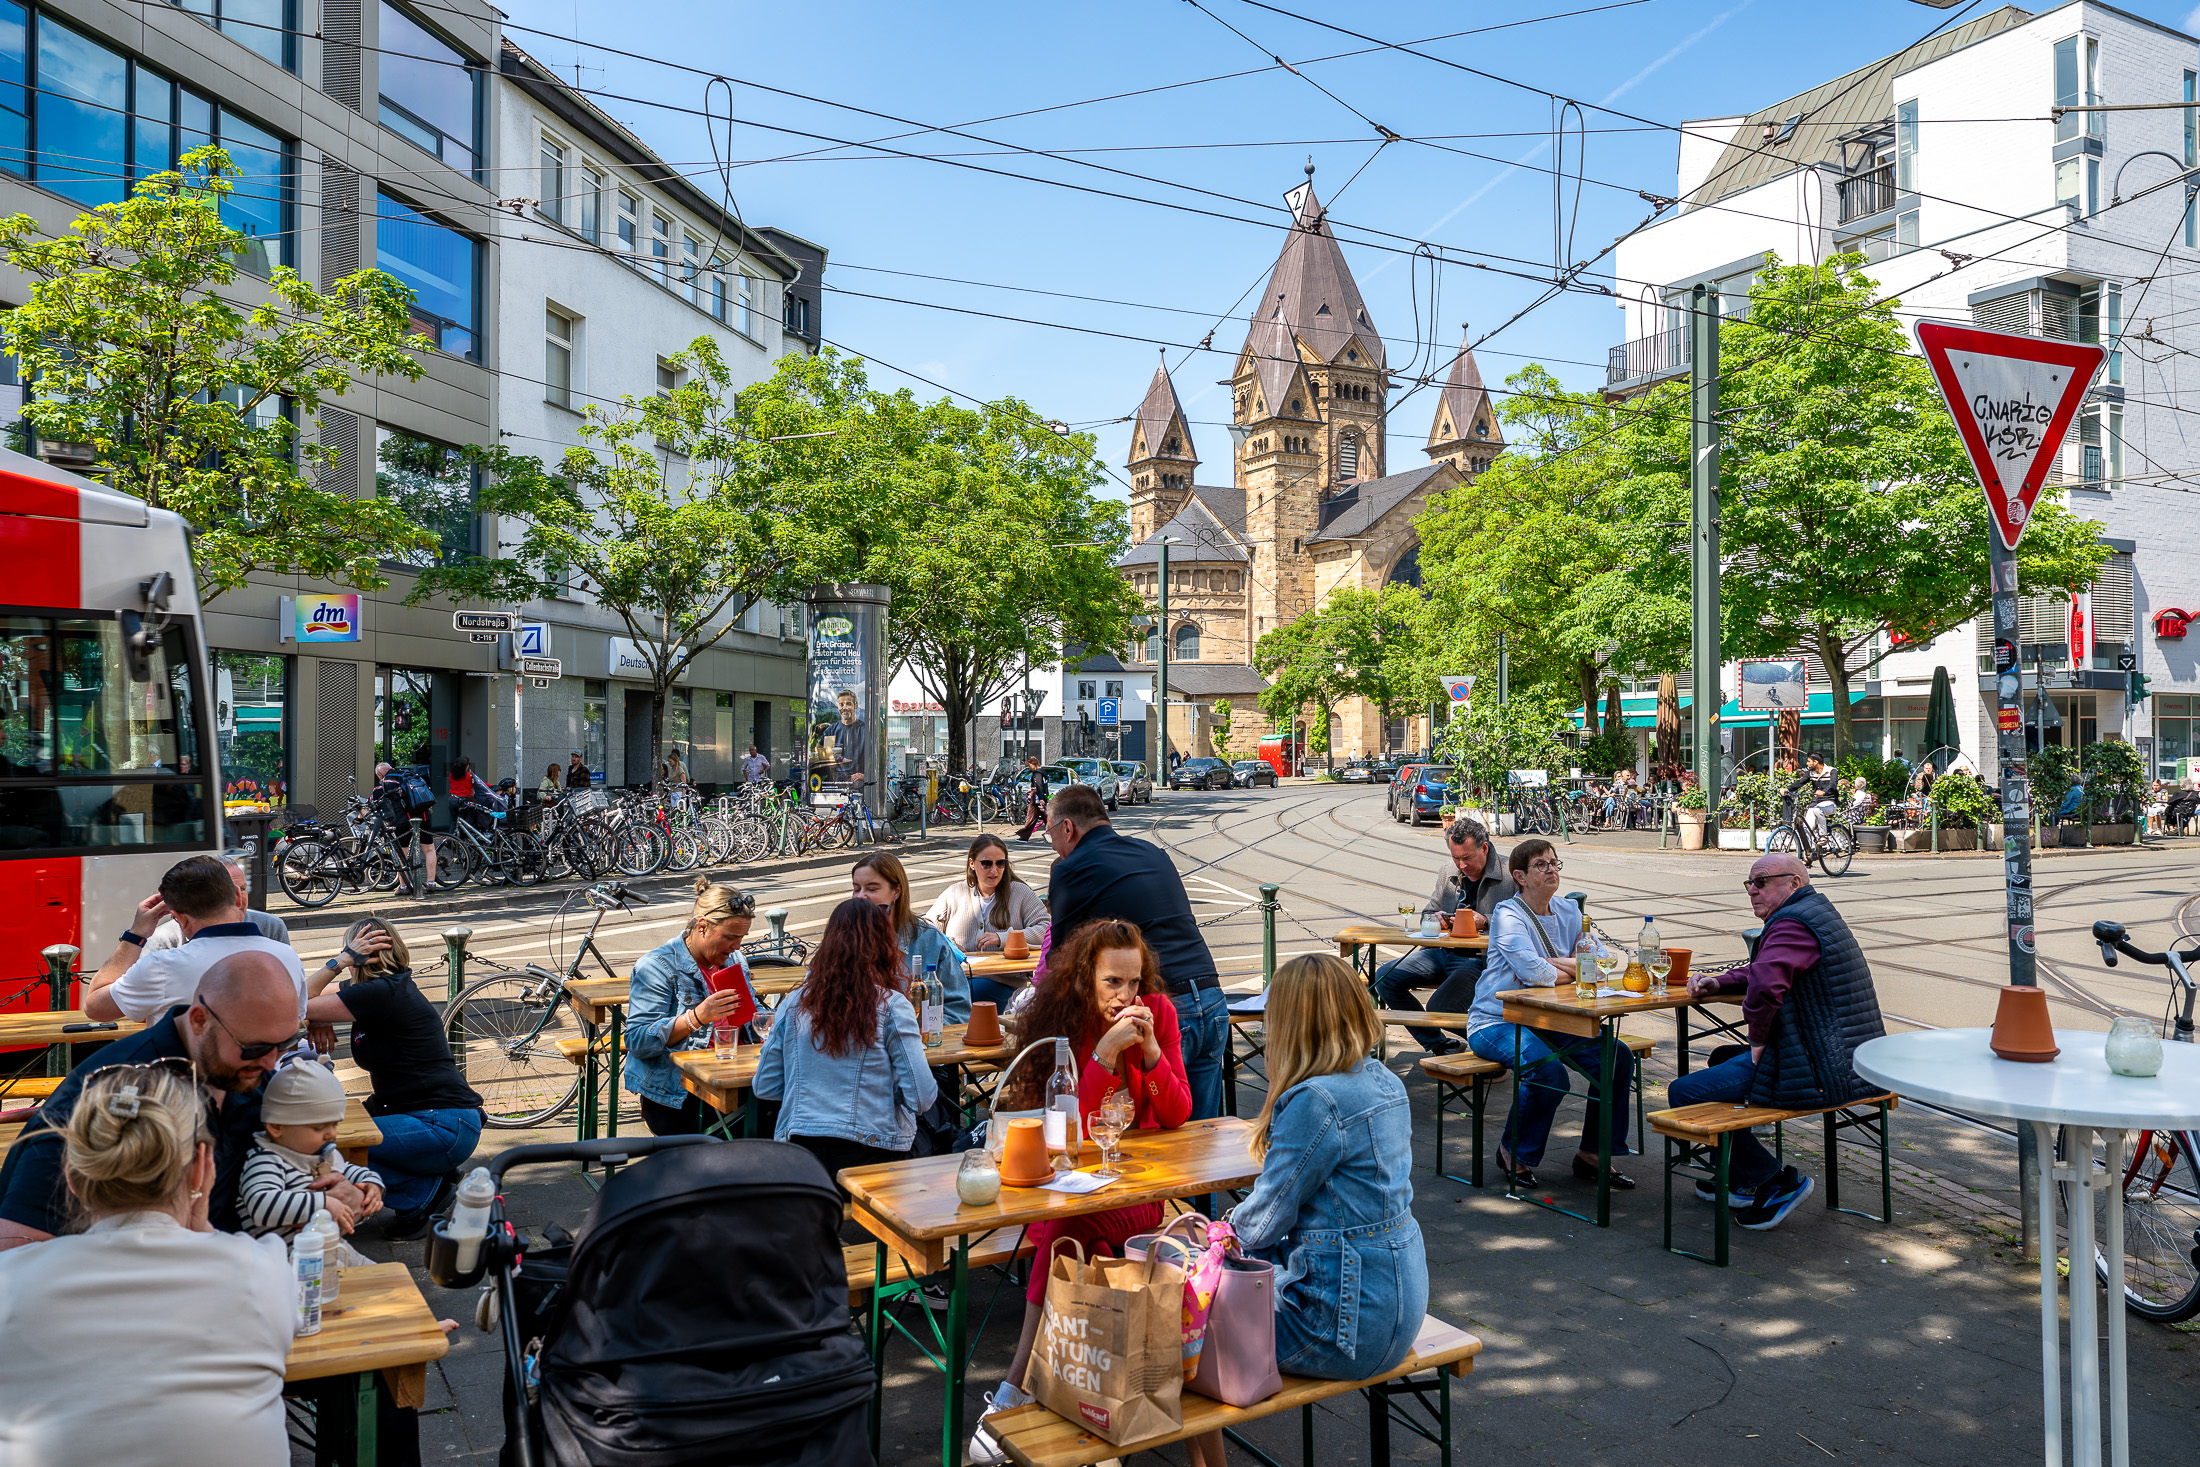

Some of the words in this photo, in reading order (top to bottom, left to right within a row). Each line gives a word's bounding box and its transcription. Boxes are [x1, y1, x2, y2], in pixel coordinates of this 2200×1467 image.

[1293, 190, 1303, 211] 2
[312, 602, 345, 623] dm
[462, 616, 505, 628] Nordstraße
[2157, 618, 2188, 638] LBS
[847, 649, 861, 657] Heu
